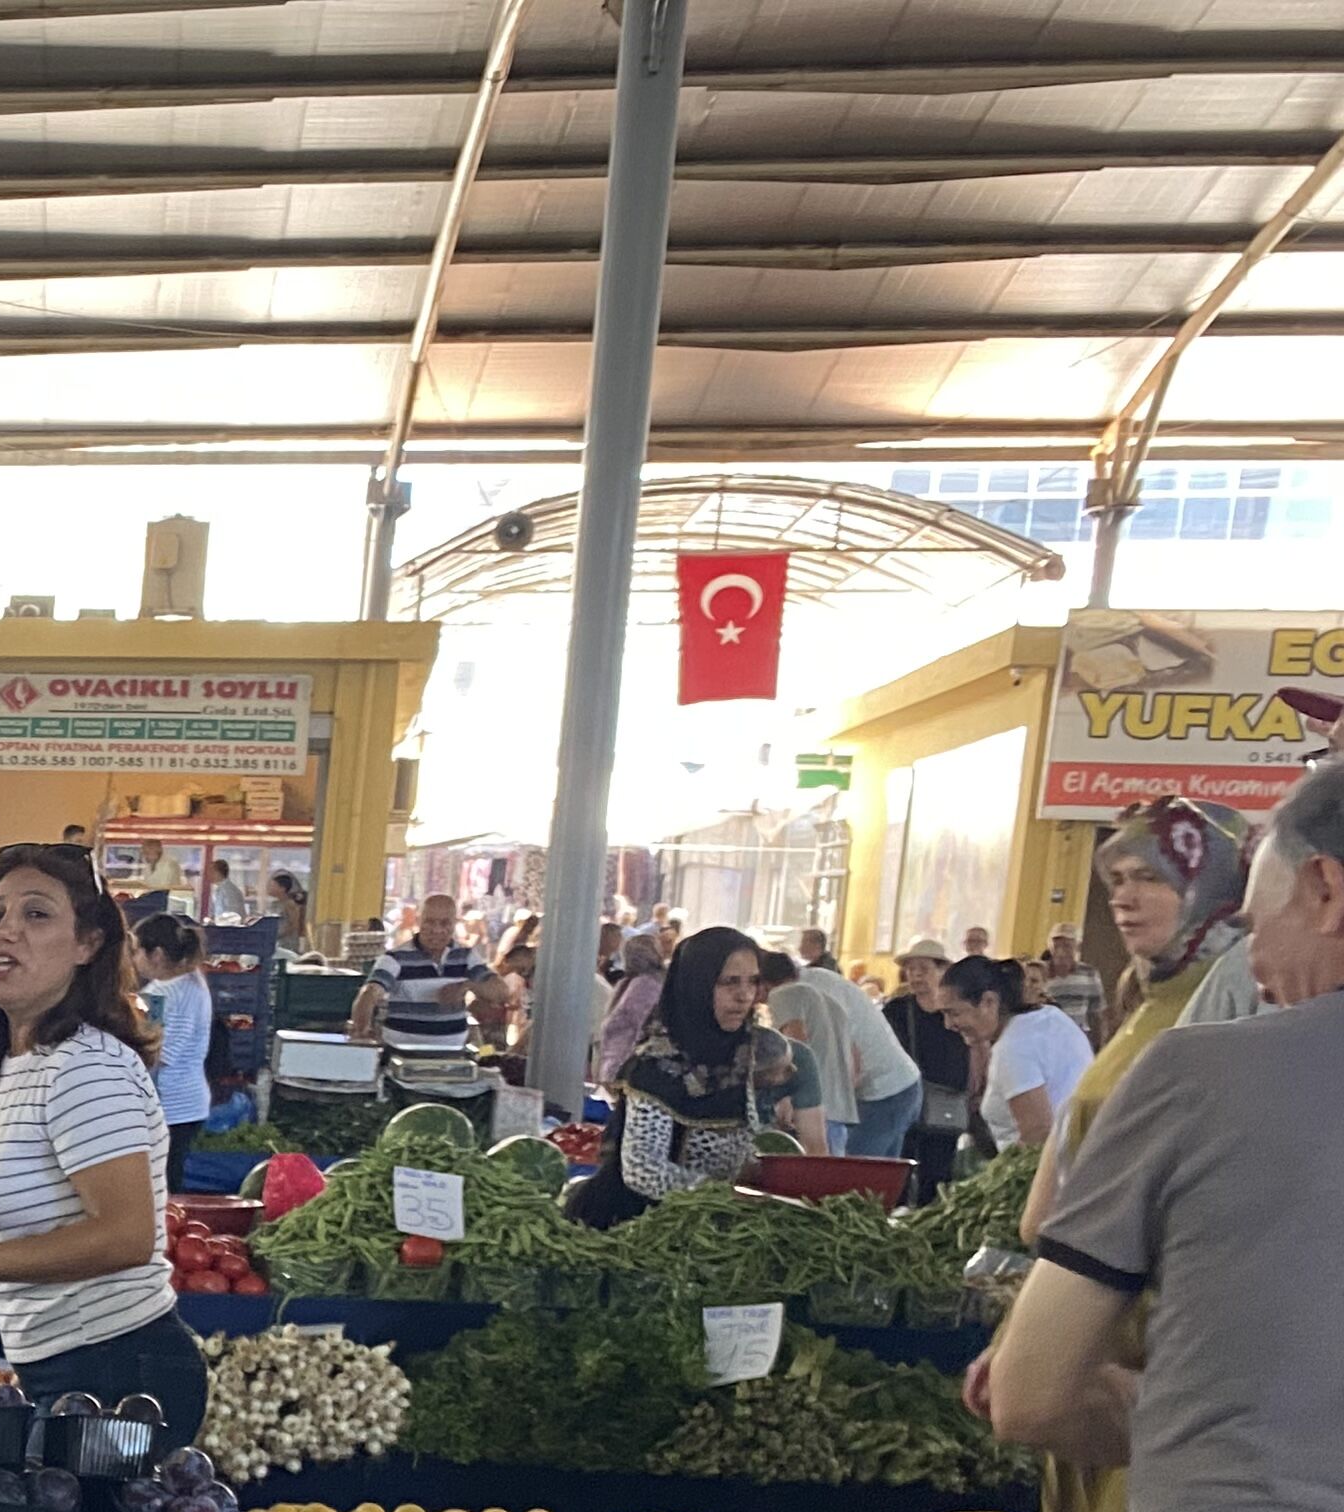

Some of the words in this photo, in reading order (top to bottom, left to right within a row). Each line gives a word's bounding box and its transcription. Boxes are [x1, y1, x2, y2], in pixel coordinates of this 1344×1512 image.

[47, 678, 191, 699] OVACIKLI
[201, 680, 299, 699] SOYLU
[1080, 691, 1305, 742] YUFKA
[1062, 771, 1087, 792] El
[1090, 773, 1183, 797] Açması
